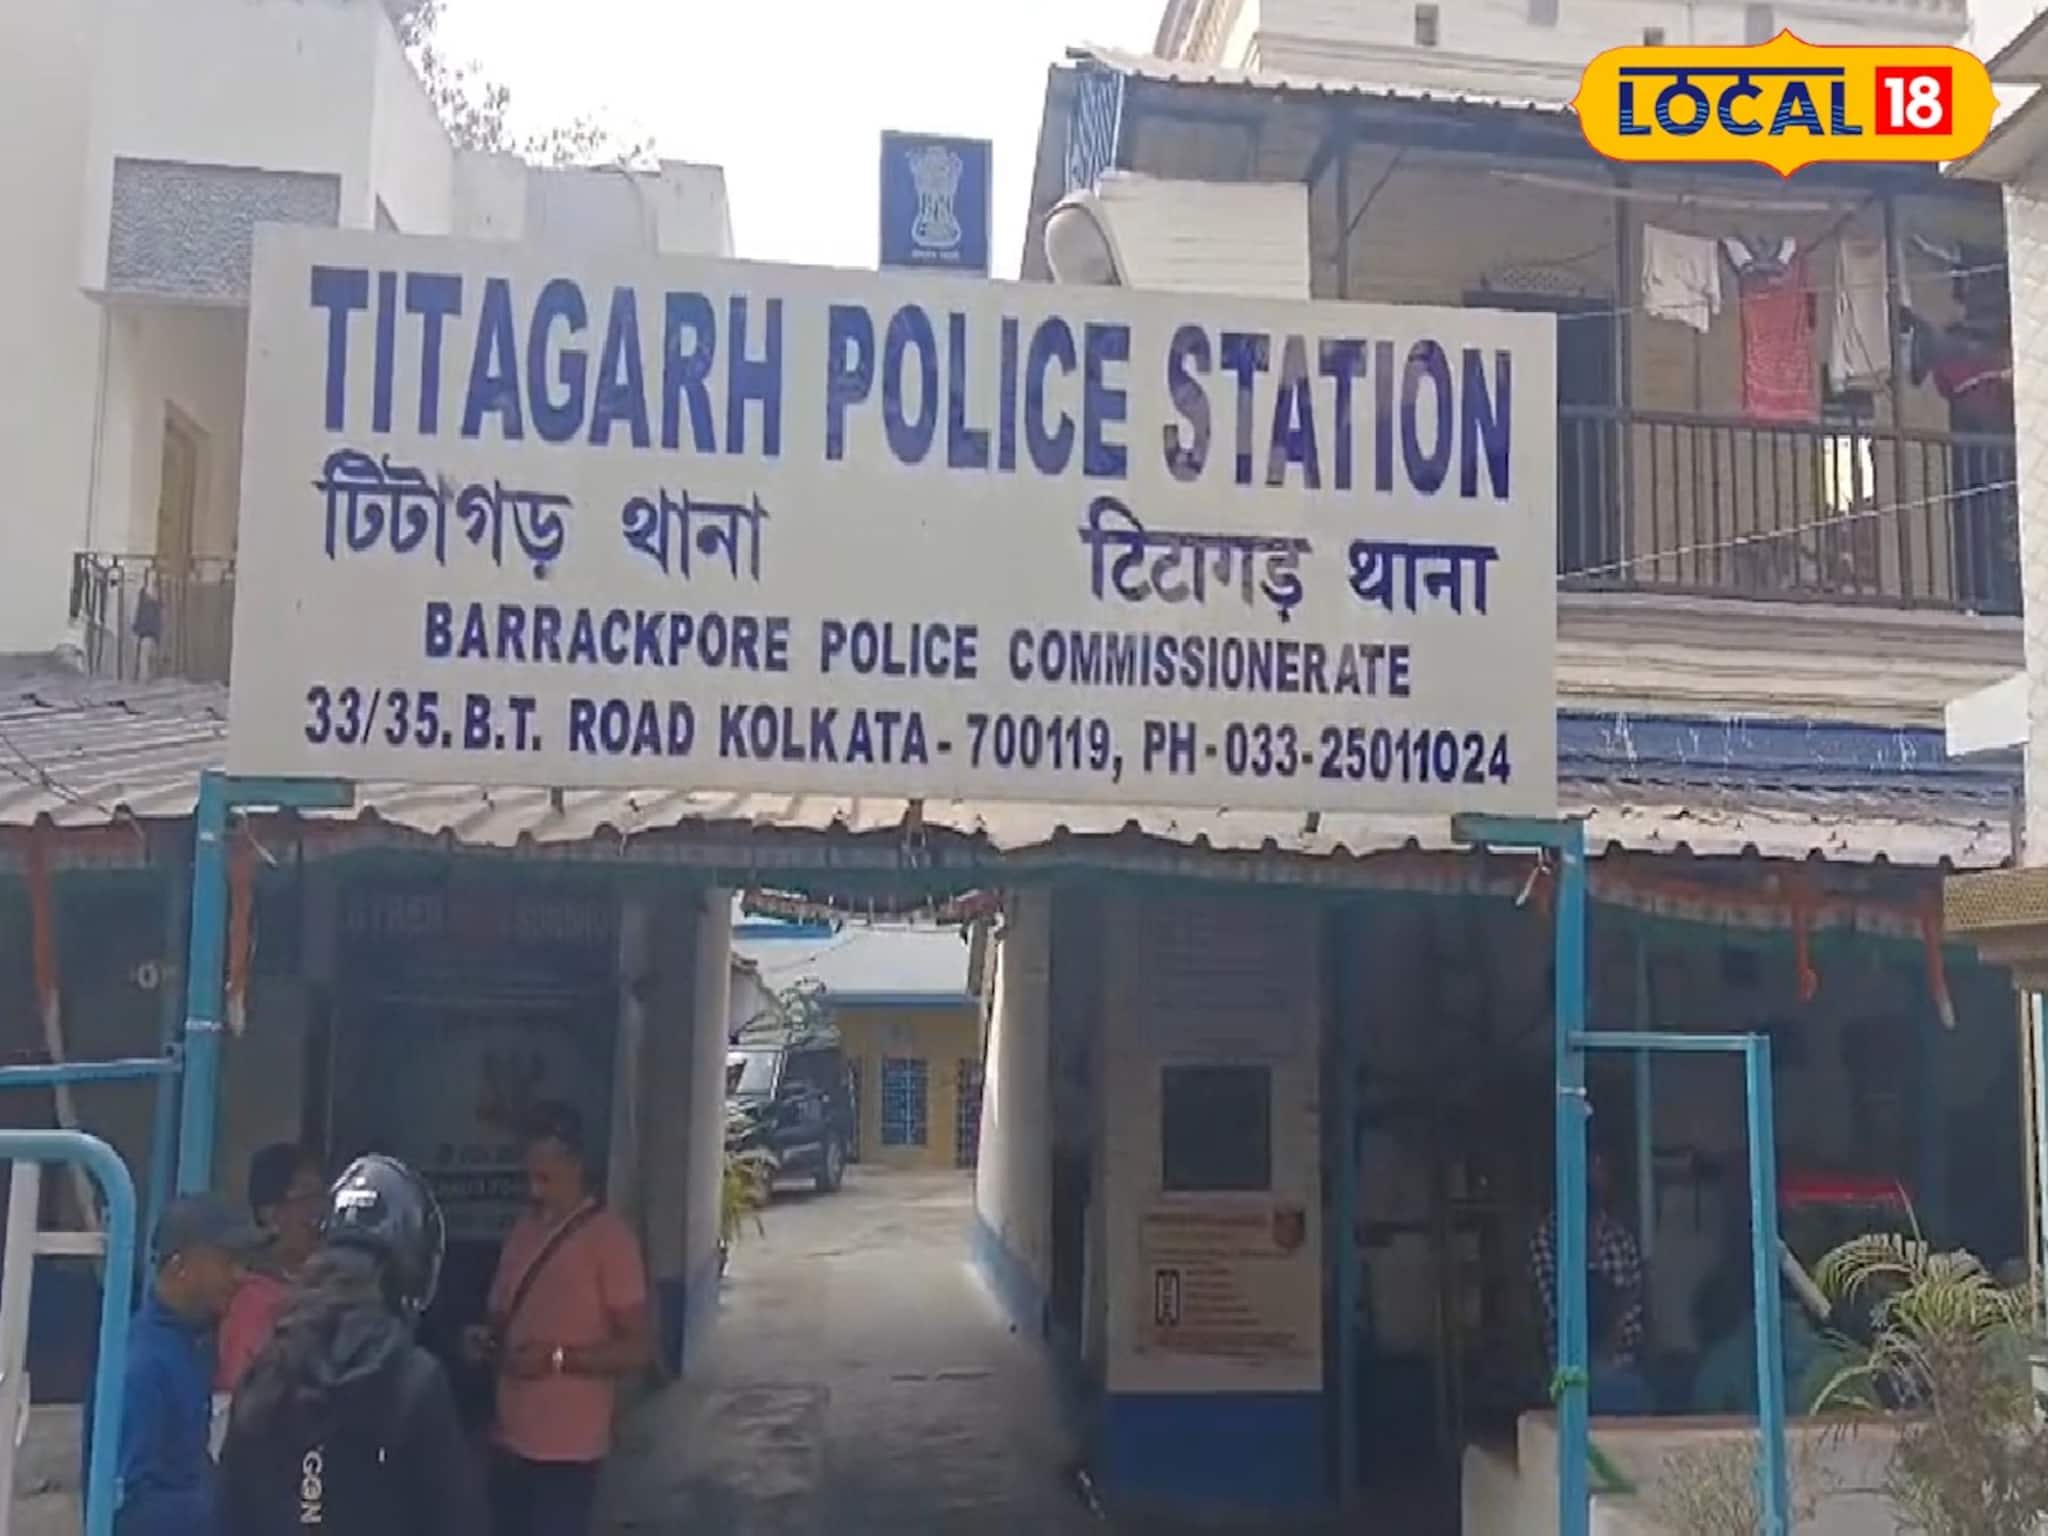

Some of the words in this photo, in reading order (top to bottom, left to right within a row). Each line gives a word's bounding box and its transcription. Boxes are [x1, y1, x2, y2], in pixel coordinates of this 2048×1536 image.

[310, 265, 783, 457] TITAGARH
[825, 303, 1131, 477] POLICE
[1162, 324, 1512, 499] STATION
[311, 448, 572, 581] টিটাগড়
[621, 487, 769, 582] থানা
[1077, 495, 1313, 624] टिटागड़
[1348, 538, 1500, 614] थाना
[425, 601, 790, 673] BARRACKPORE
[820, 620, 979, 680] POLICE
[1009, 628, 1411, 699] COMMISSIONERATE
[568, 698, 695, 757] ROAD
